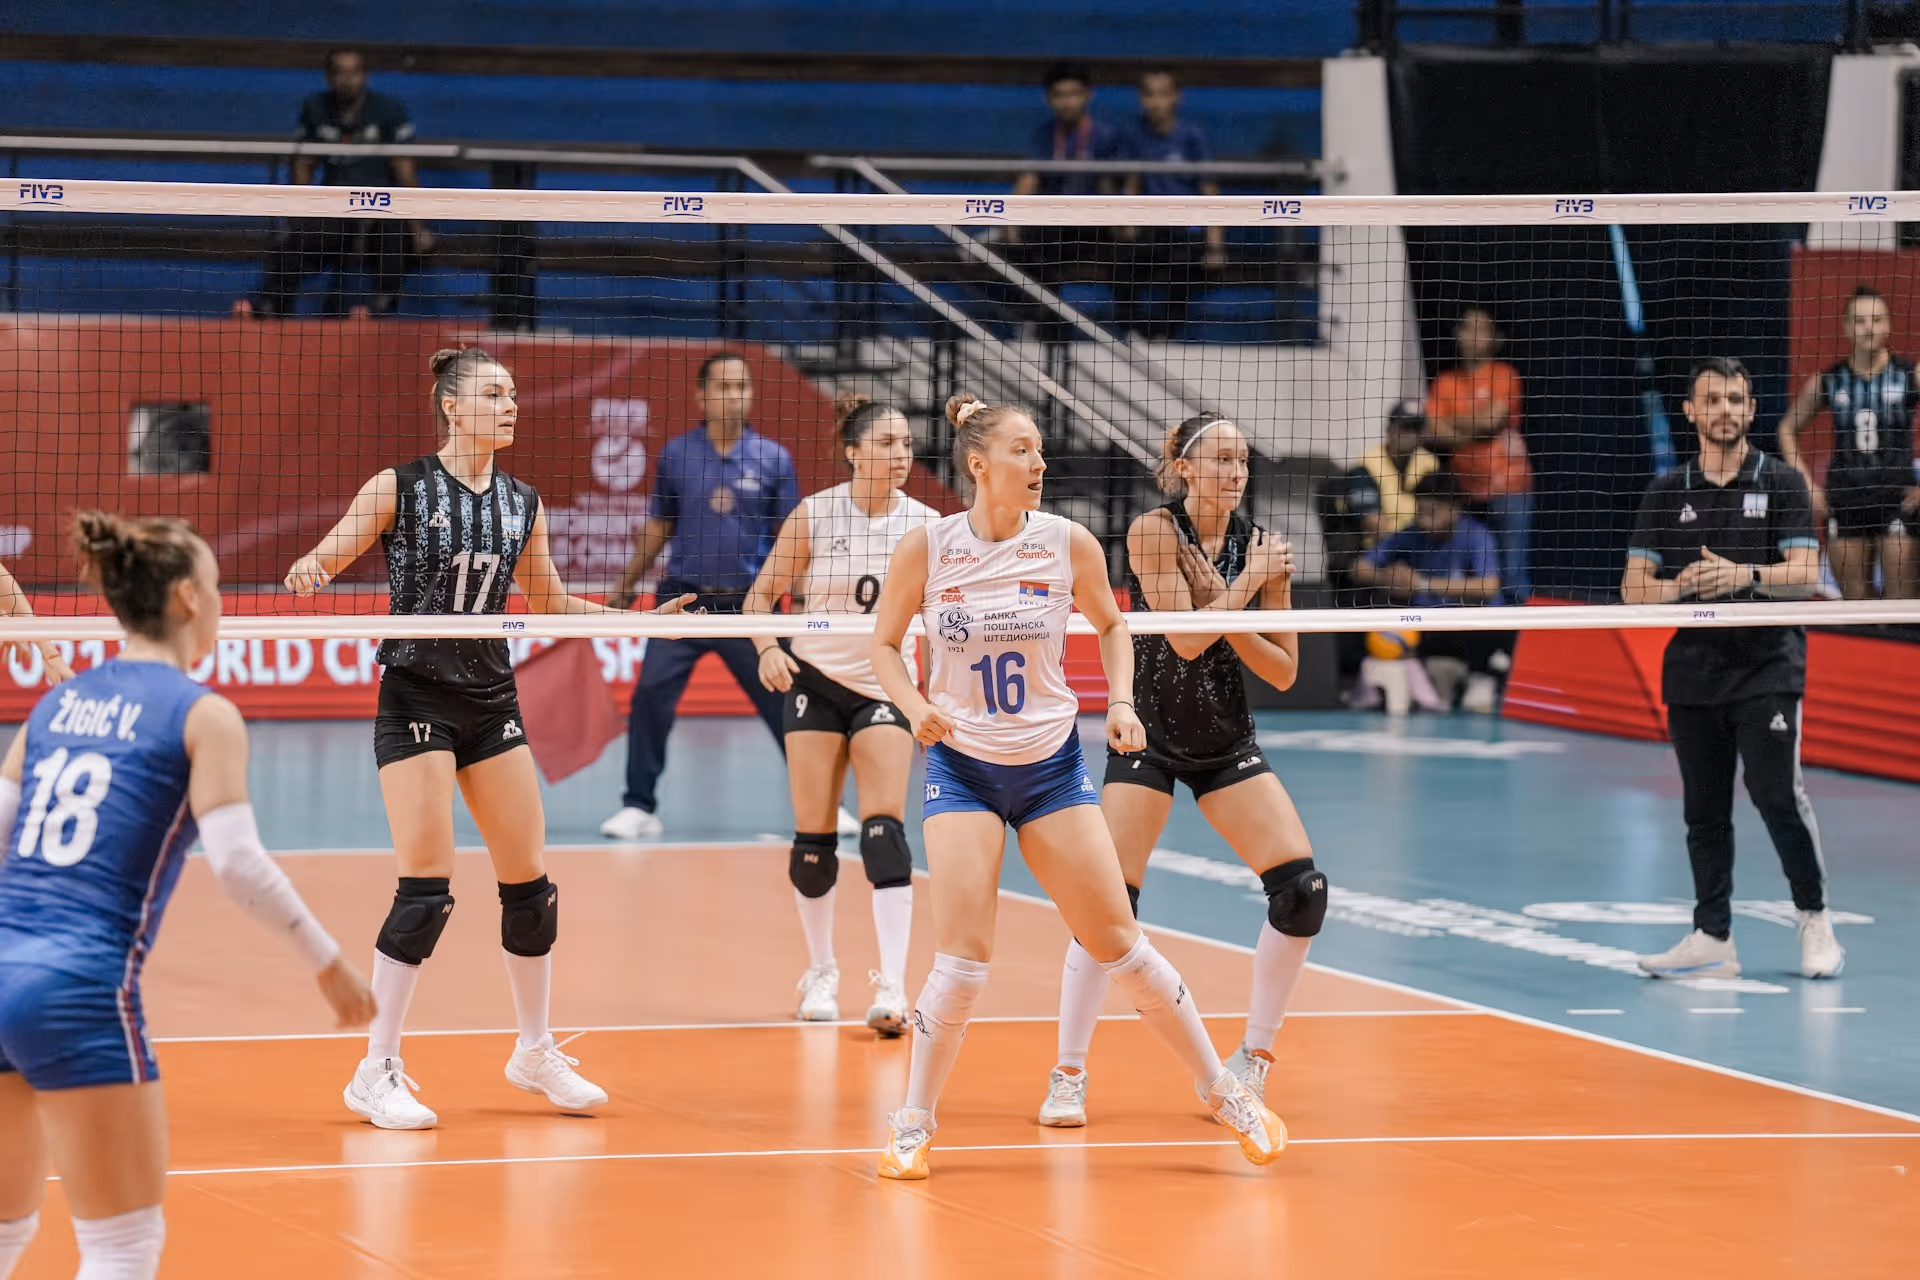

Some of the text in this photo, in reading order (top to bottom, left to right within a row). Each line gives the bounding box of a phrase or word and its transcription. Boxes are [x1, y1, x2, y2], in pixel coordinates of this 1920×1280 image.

[19, 184, 64, 200] FIVB
[349, 191, 391, 207] FIVB
[663, 196, 704, 212] FIVB
[965, 199, 1005, 214] FIVB
[1262, 200, 1302, 215] FIVB
[1555, 199, 1594, 213] FIVB
[1848, 196, 1888, 210] FIVB
[1854, 408, 1879, 455] 8
[450, 550, 501, 613] 17
[855, 574, 880, 615] 9
[941, 594, 966, 603] PEAK
[984, 611, 1018, 621] БАНКА
[502, 621, 525, 630] FIVB
[807, 621, 830, 629] FIVB
[983, 620, 1046, 632] ПОШТАНСКА
[983, 632, 1051, 643] ШТЕДИОНИЦА
[970, 651, 1026, 715] 16
[795, 693, 809, 719] 9
[48, 688, 143, 742] ŽIGIĆ V.
[408, 721, 432, 744] 17
[17, 746, 113, 868] 18
